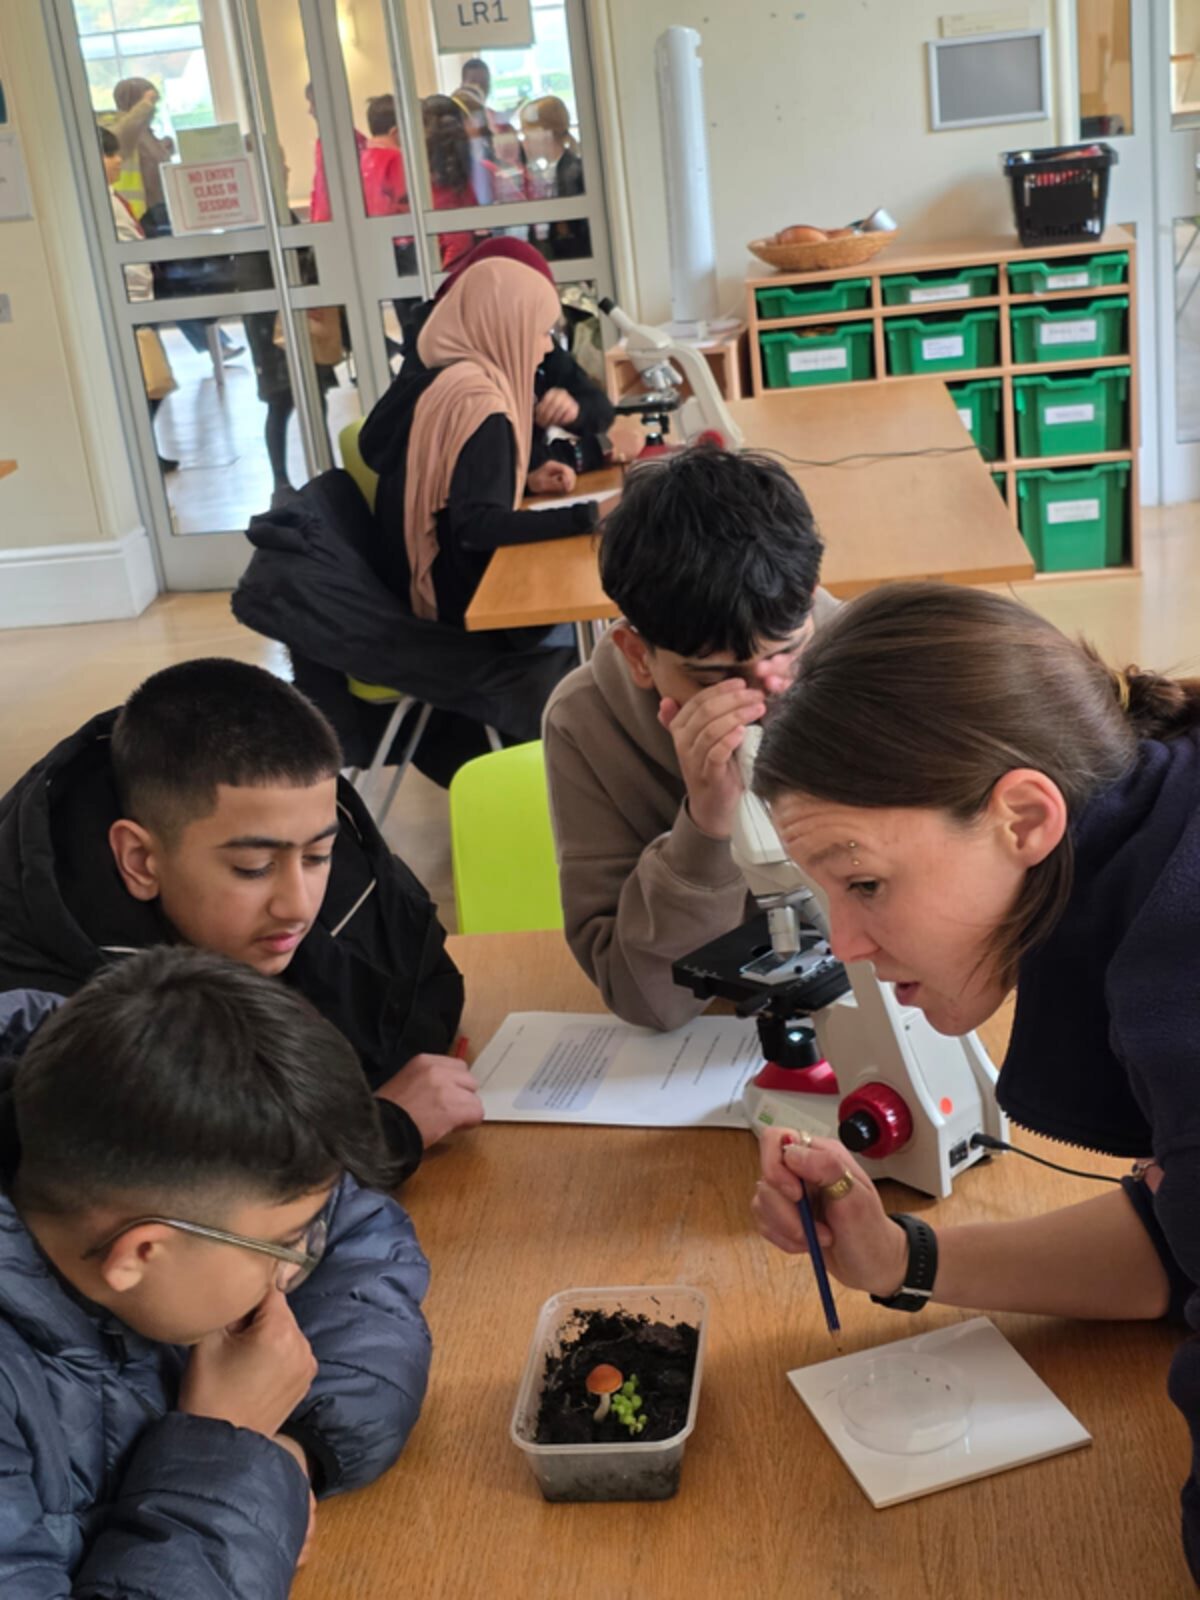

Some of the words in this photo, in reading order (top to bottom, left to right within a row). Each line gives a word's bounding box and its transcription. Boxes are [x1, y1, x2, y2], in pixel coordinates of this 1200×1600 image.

[457, 0, 509, 27] LR1
[188, 171, 202, 183] NO
[205, 168, 235, 182] ENTRY
[193, 184, 225, 198] CLASS
[227, 182, 238, 194] IN
[198, 198, 239, 212] SESSION
